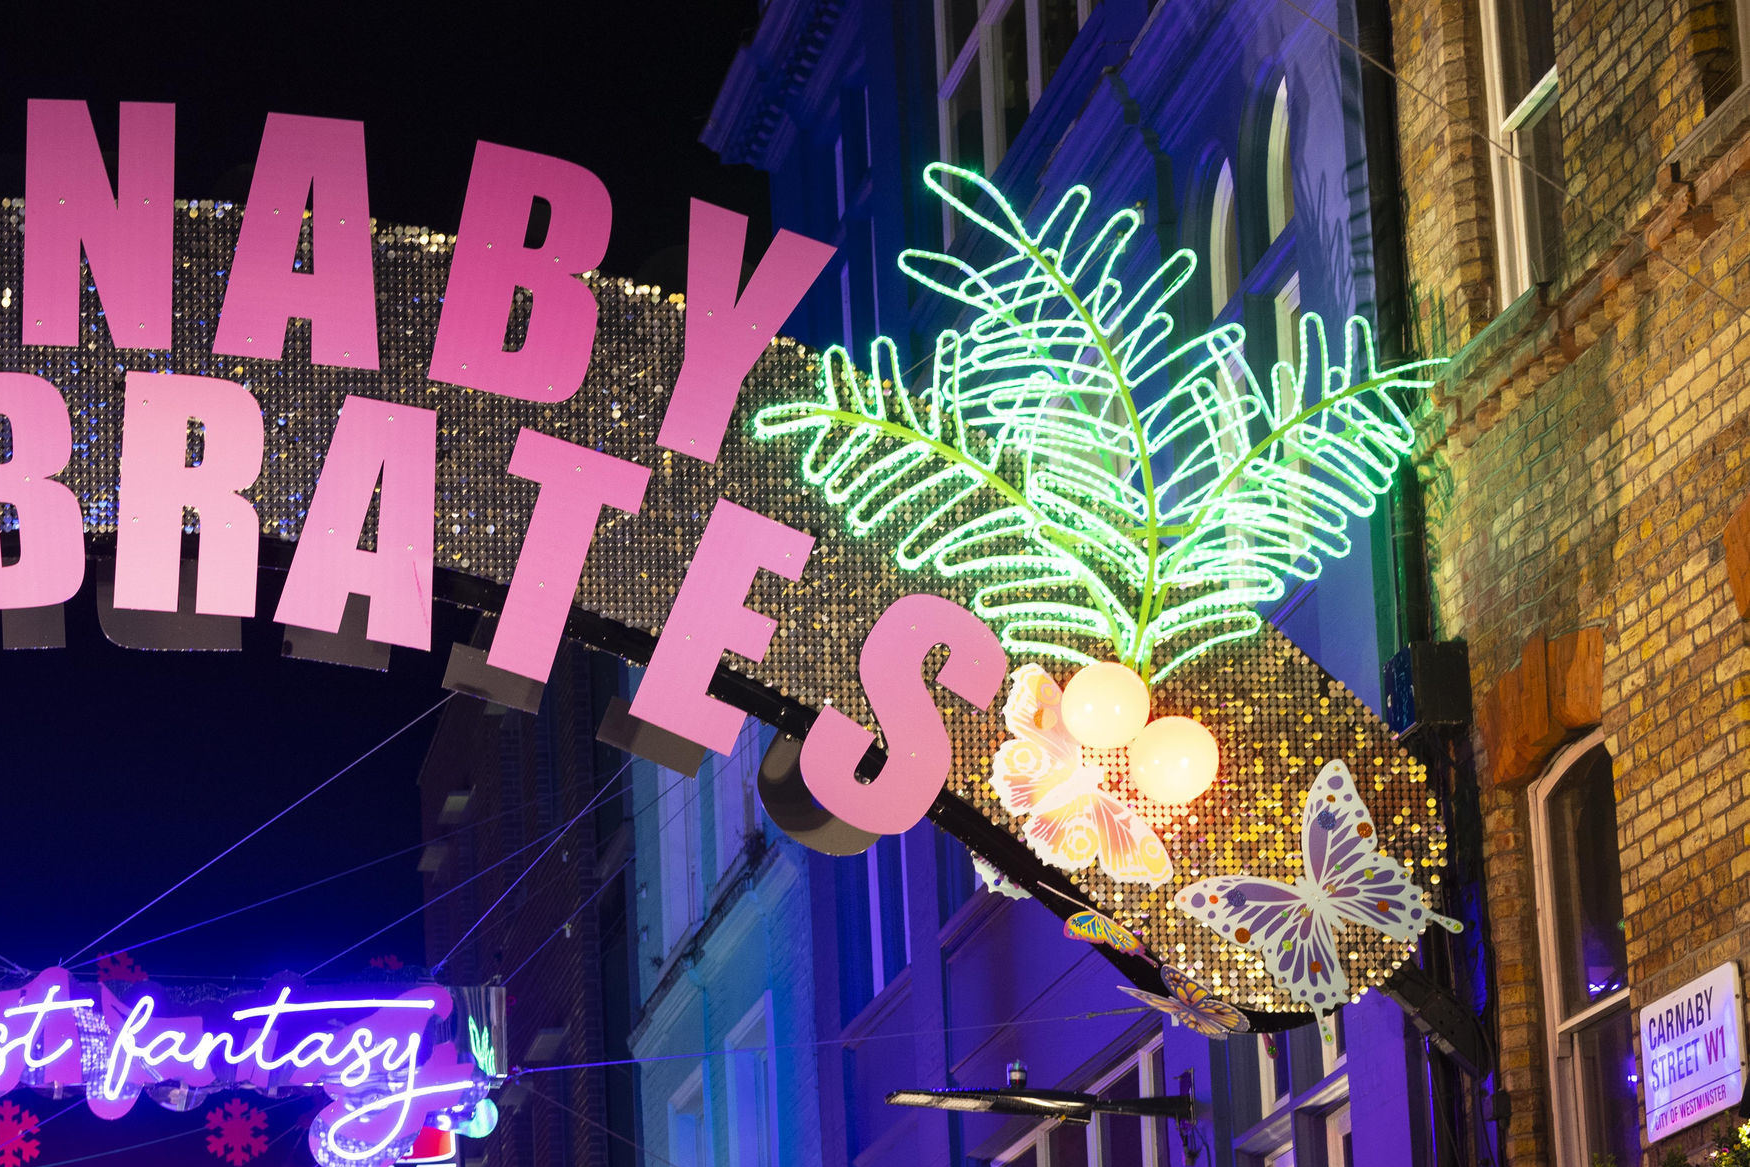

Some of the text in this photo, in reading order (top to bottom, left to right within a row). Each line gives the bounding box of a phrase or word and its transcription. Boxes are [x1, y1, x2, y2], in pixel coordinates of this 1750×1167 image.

[1648, 986, 1713, 1051] CARNABY
[104, 986, 474, 1161] fantasy
[1651, 1025, 1727, 1092] STREET W1
[1655, 1084, 1727, 1131] CITY OF WESTMINSTER
